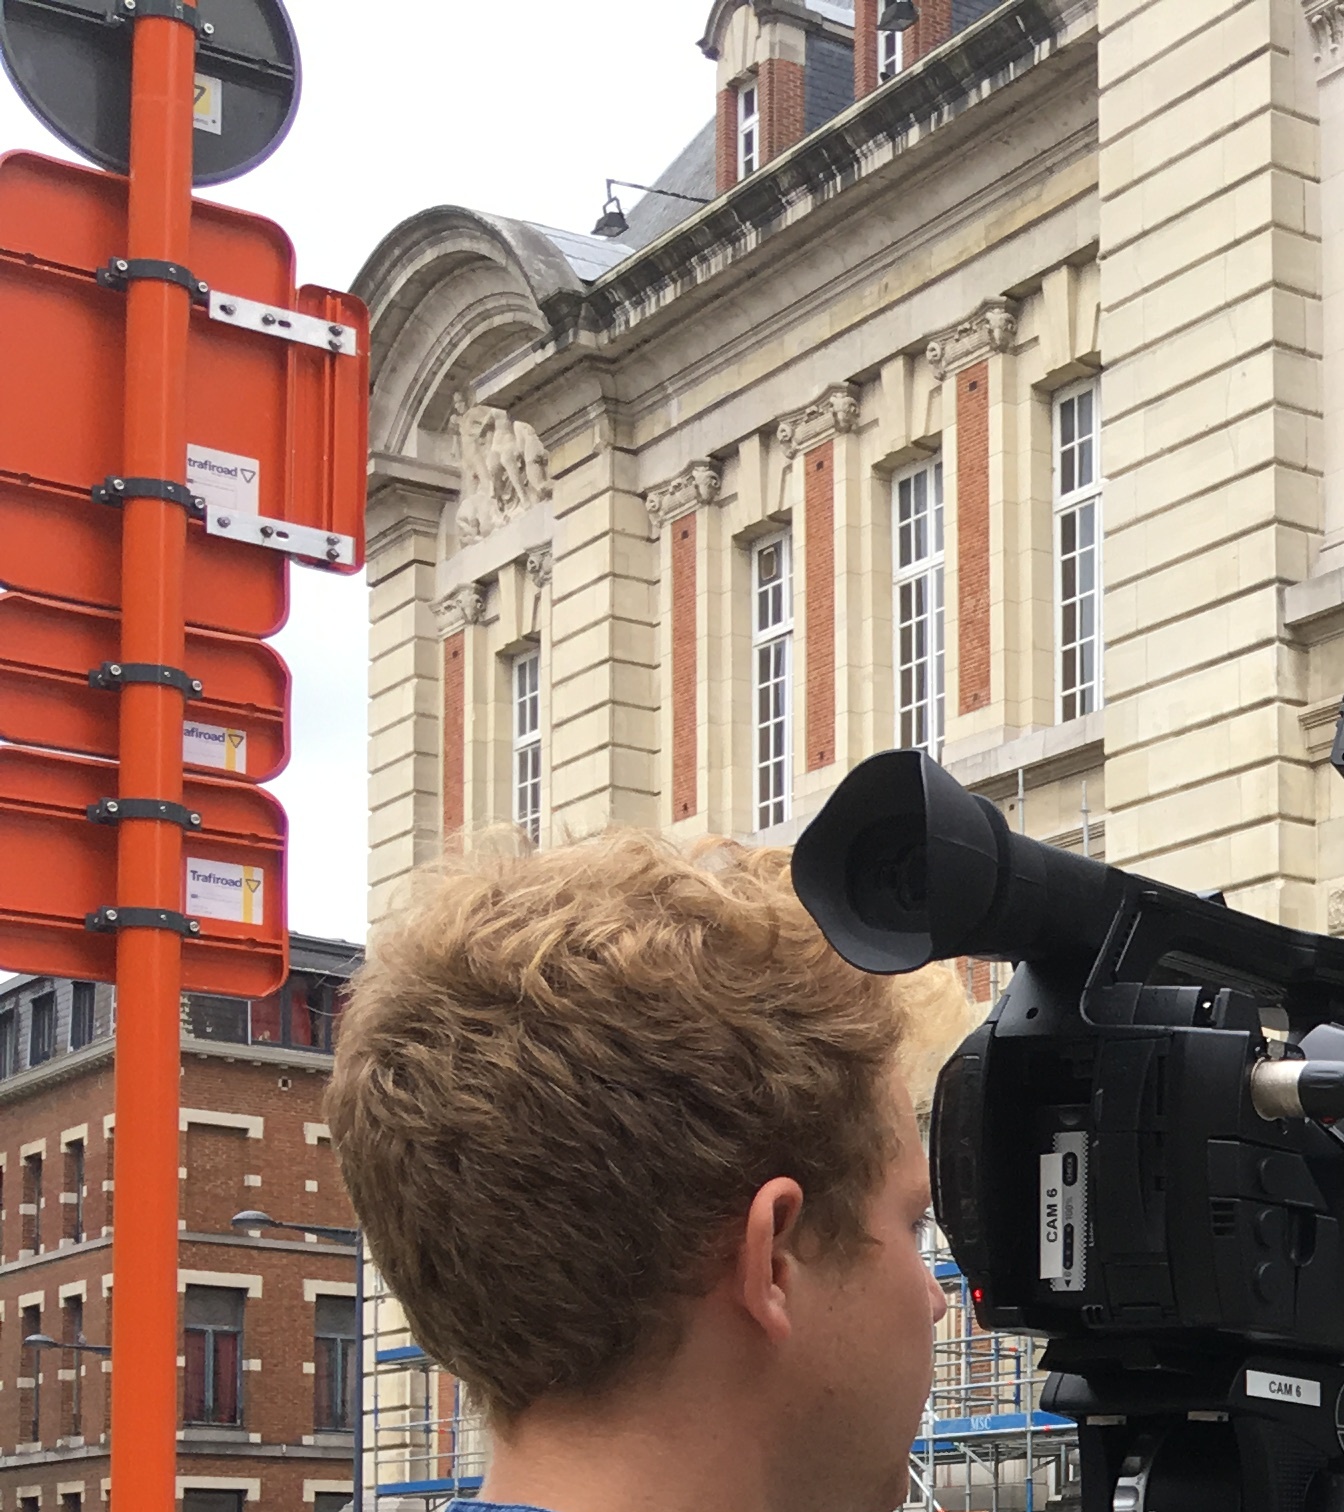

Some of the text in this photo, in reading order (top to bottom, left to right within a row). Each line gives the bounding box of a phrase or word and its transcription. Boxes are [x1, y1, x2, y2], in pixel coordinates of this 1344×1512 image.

[188, 458, 238, 477] trafiroad
[190, 870, 242, 887] Trafiroad
[1047, 1188, 1058, 1243] CAM 6
[1268, 1381, 1302, 1397] CAM 6
